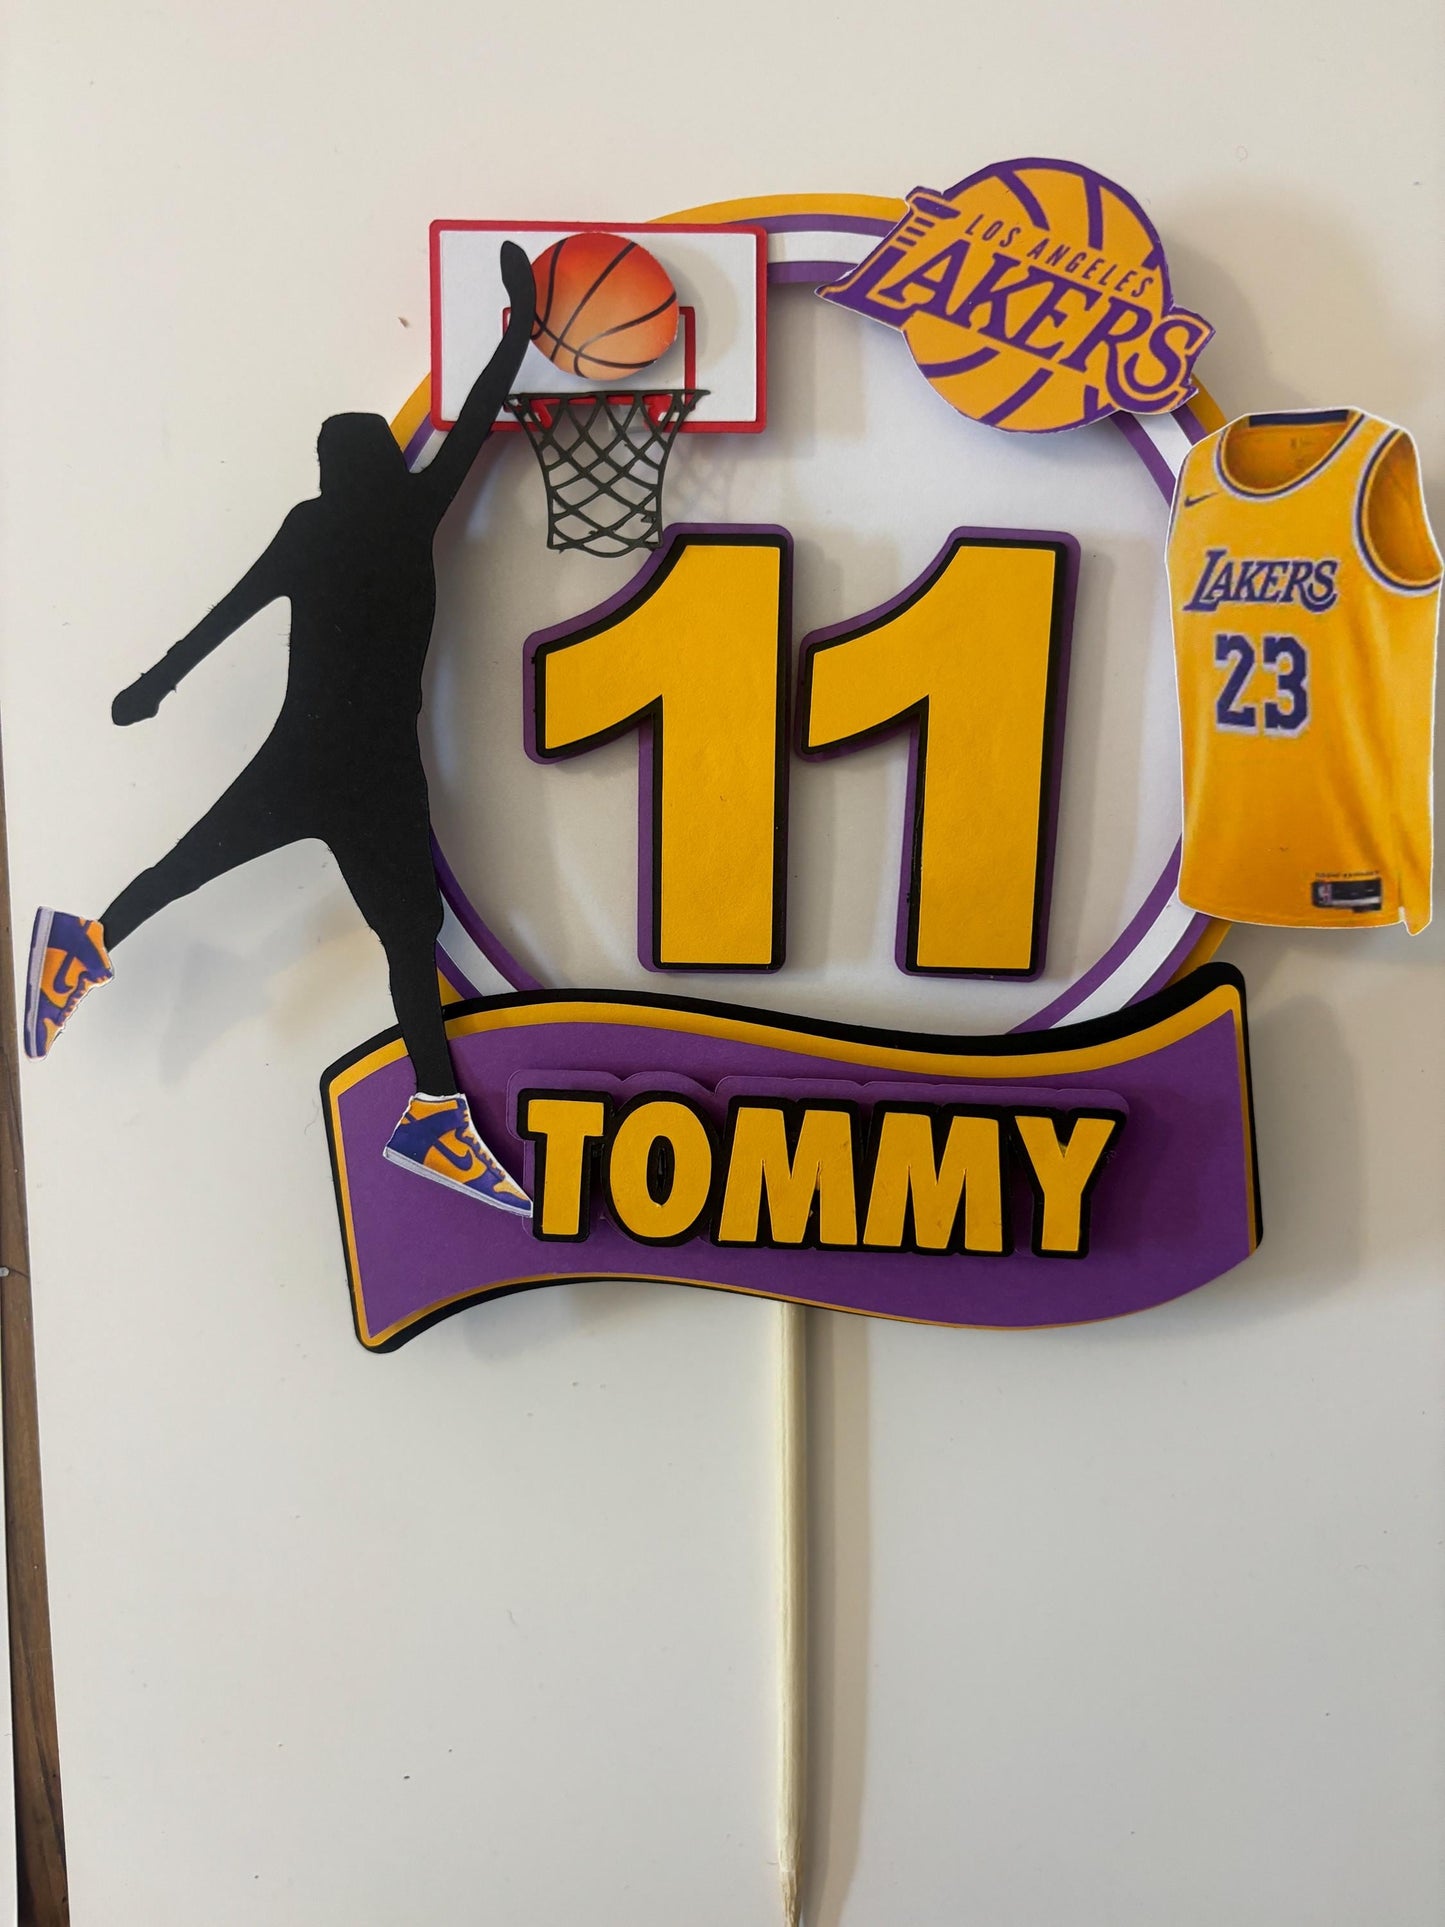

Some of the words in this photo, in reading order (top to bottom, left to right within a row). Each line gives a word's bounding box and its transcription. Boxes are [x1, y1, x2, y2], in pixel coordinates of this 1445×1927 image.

[816, 187, 1214, 413] LAKERS
[964, 213, 1021, 248] LOS
[1026, 238, 1155, 299] ANGELES
[1182, 549, 1339, 614] LAKERS
[1213, 632, 1310, 738] 23
[534, 534, 1066, 975] 11
[519, 1090, 1124, 1258] TOMMY
